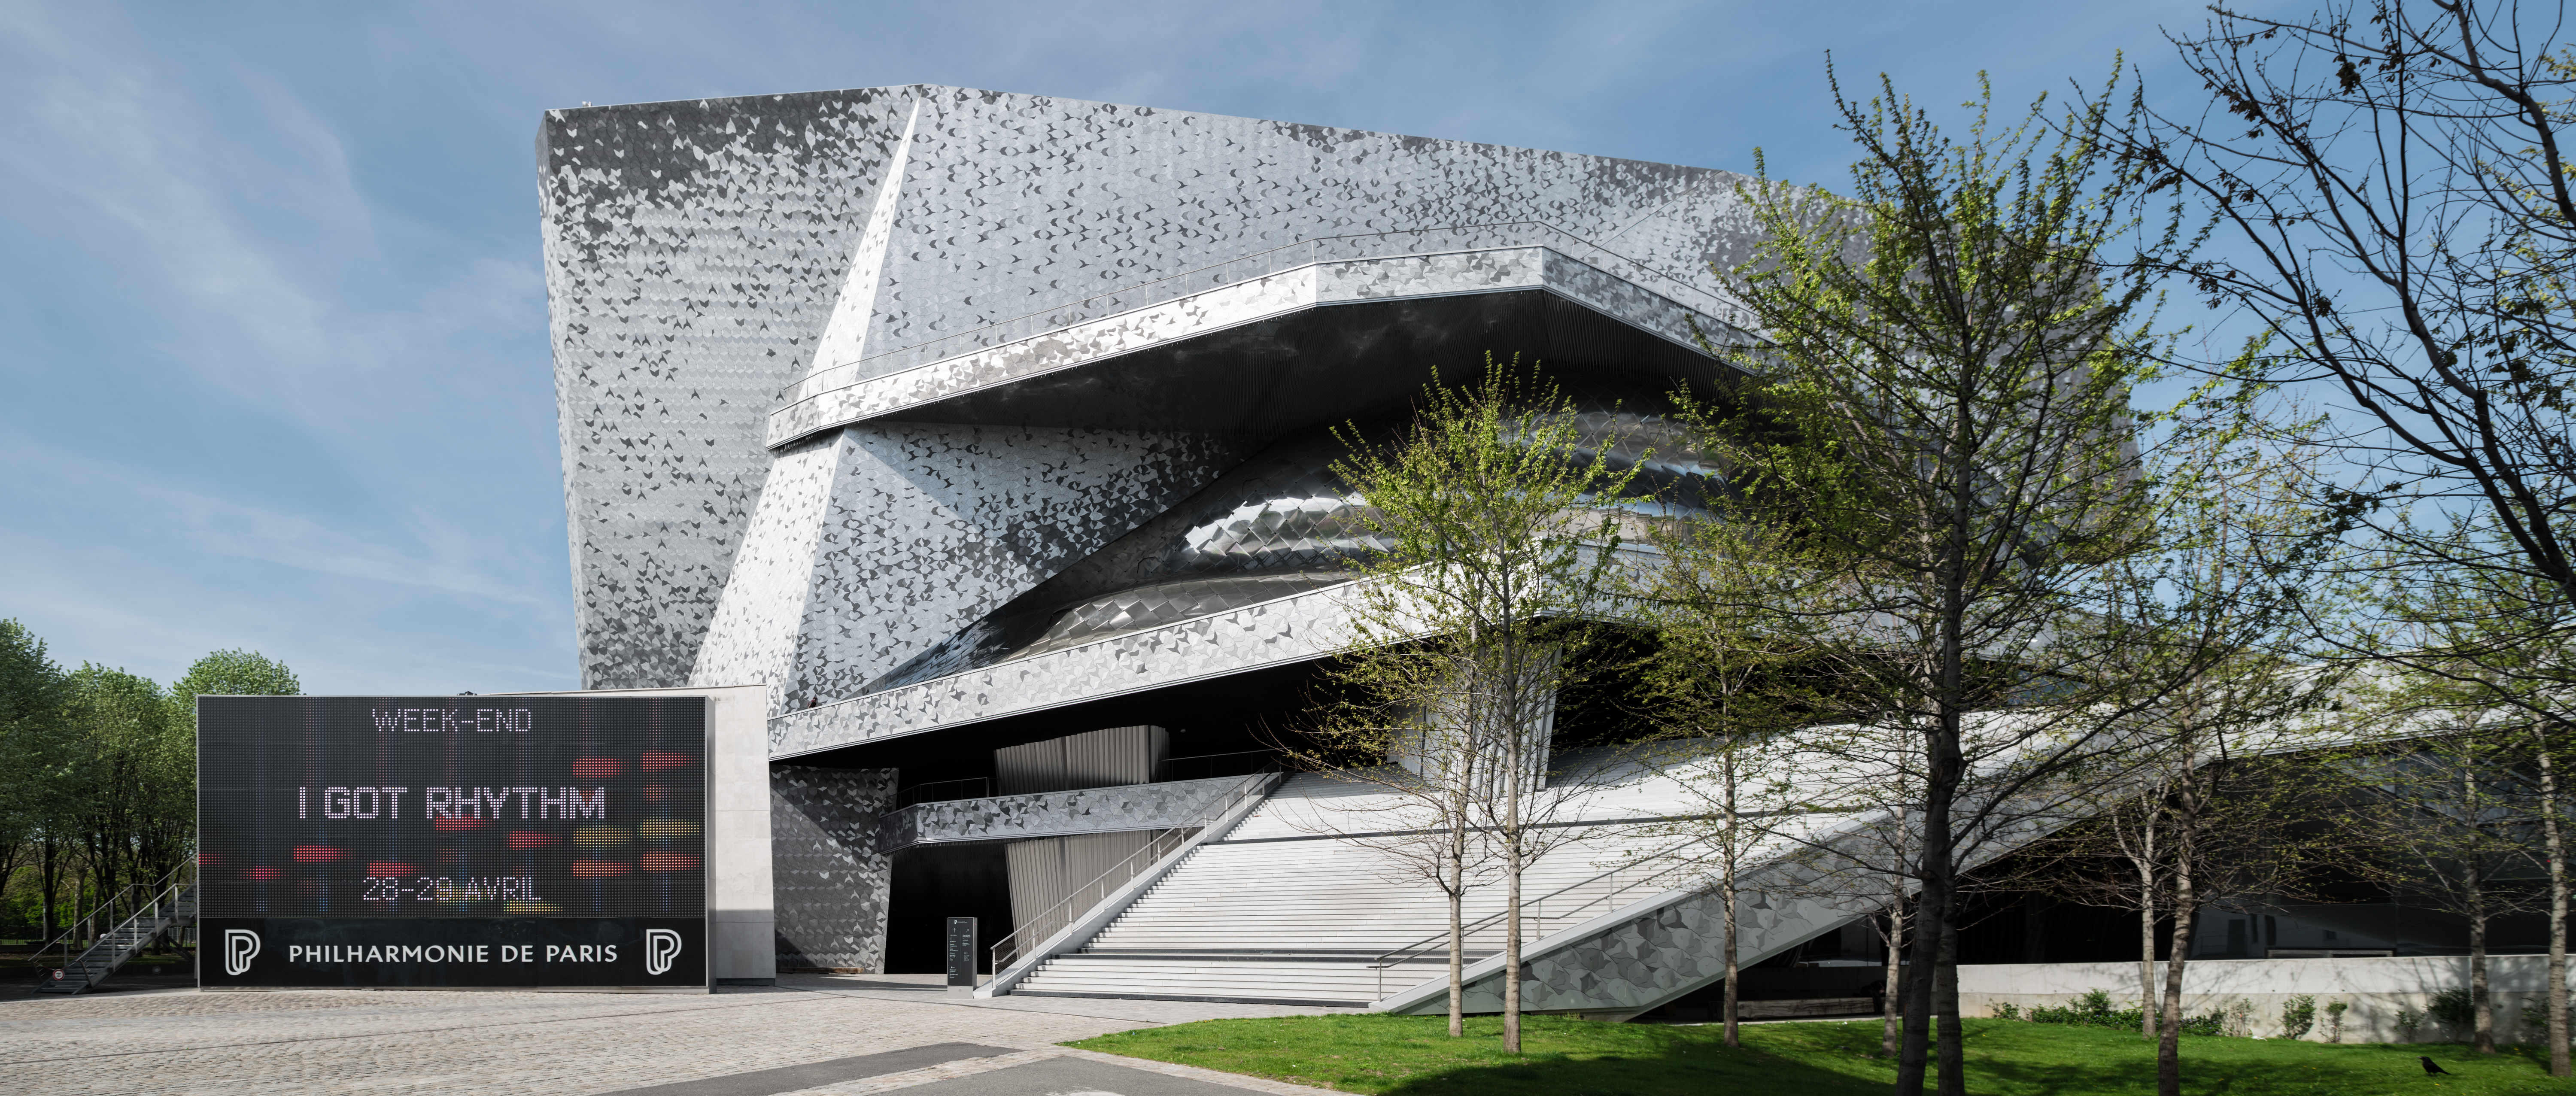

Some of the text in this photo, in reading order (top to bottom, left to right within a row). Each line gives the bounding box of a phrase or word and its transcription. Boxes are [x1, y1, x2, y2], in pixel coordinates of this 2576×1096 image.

[372, 709, 531, 732] WEEK-END
[300, 787, 604, 819] I GOT RHYTHM
[363, 877, 541, 900] 28-29 AVRIL
[289, 944, 617, 963] PHILHARMONIE DE PARIS
